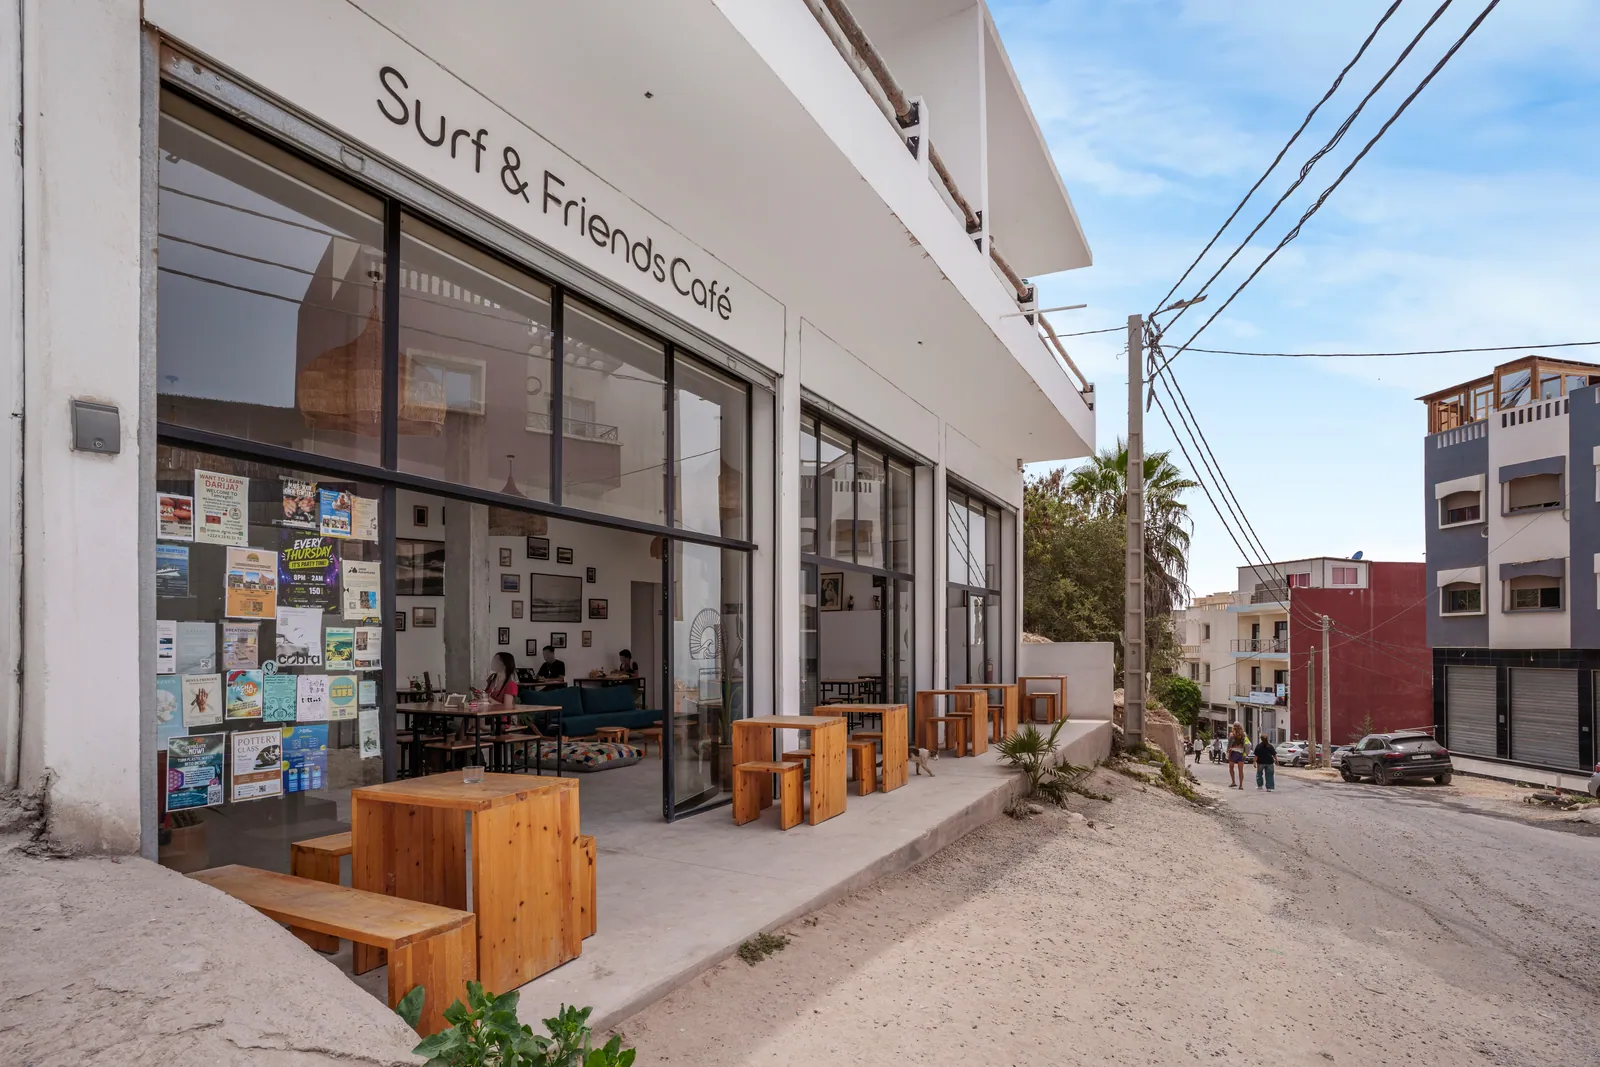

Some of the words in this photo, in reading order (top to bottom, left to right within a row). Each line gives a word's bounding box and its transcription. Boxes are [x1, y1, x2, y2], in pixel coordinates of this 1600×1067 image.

[377, 66, 489, 173] Surf
[500, 146, 530, 204] &
[542, 170, 667, 283] Friends
[669, 256, 732, 321] Café
[205, 480, 239, 491] DARIJA?
[293, 537, 323, 550] EVERY
[284, 545, 333, 561] THURSDAY
[311, 574, 324, 582] 2AM
[309, 587, 320, 595] 150
[277, 653, 320, 665] cobra
[237, 736, 277, 746] POTTERY
